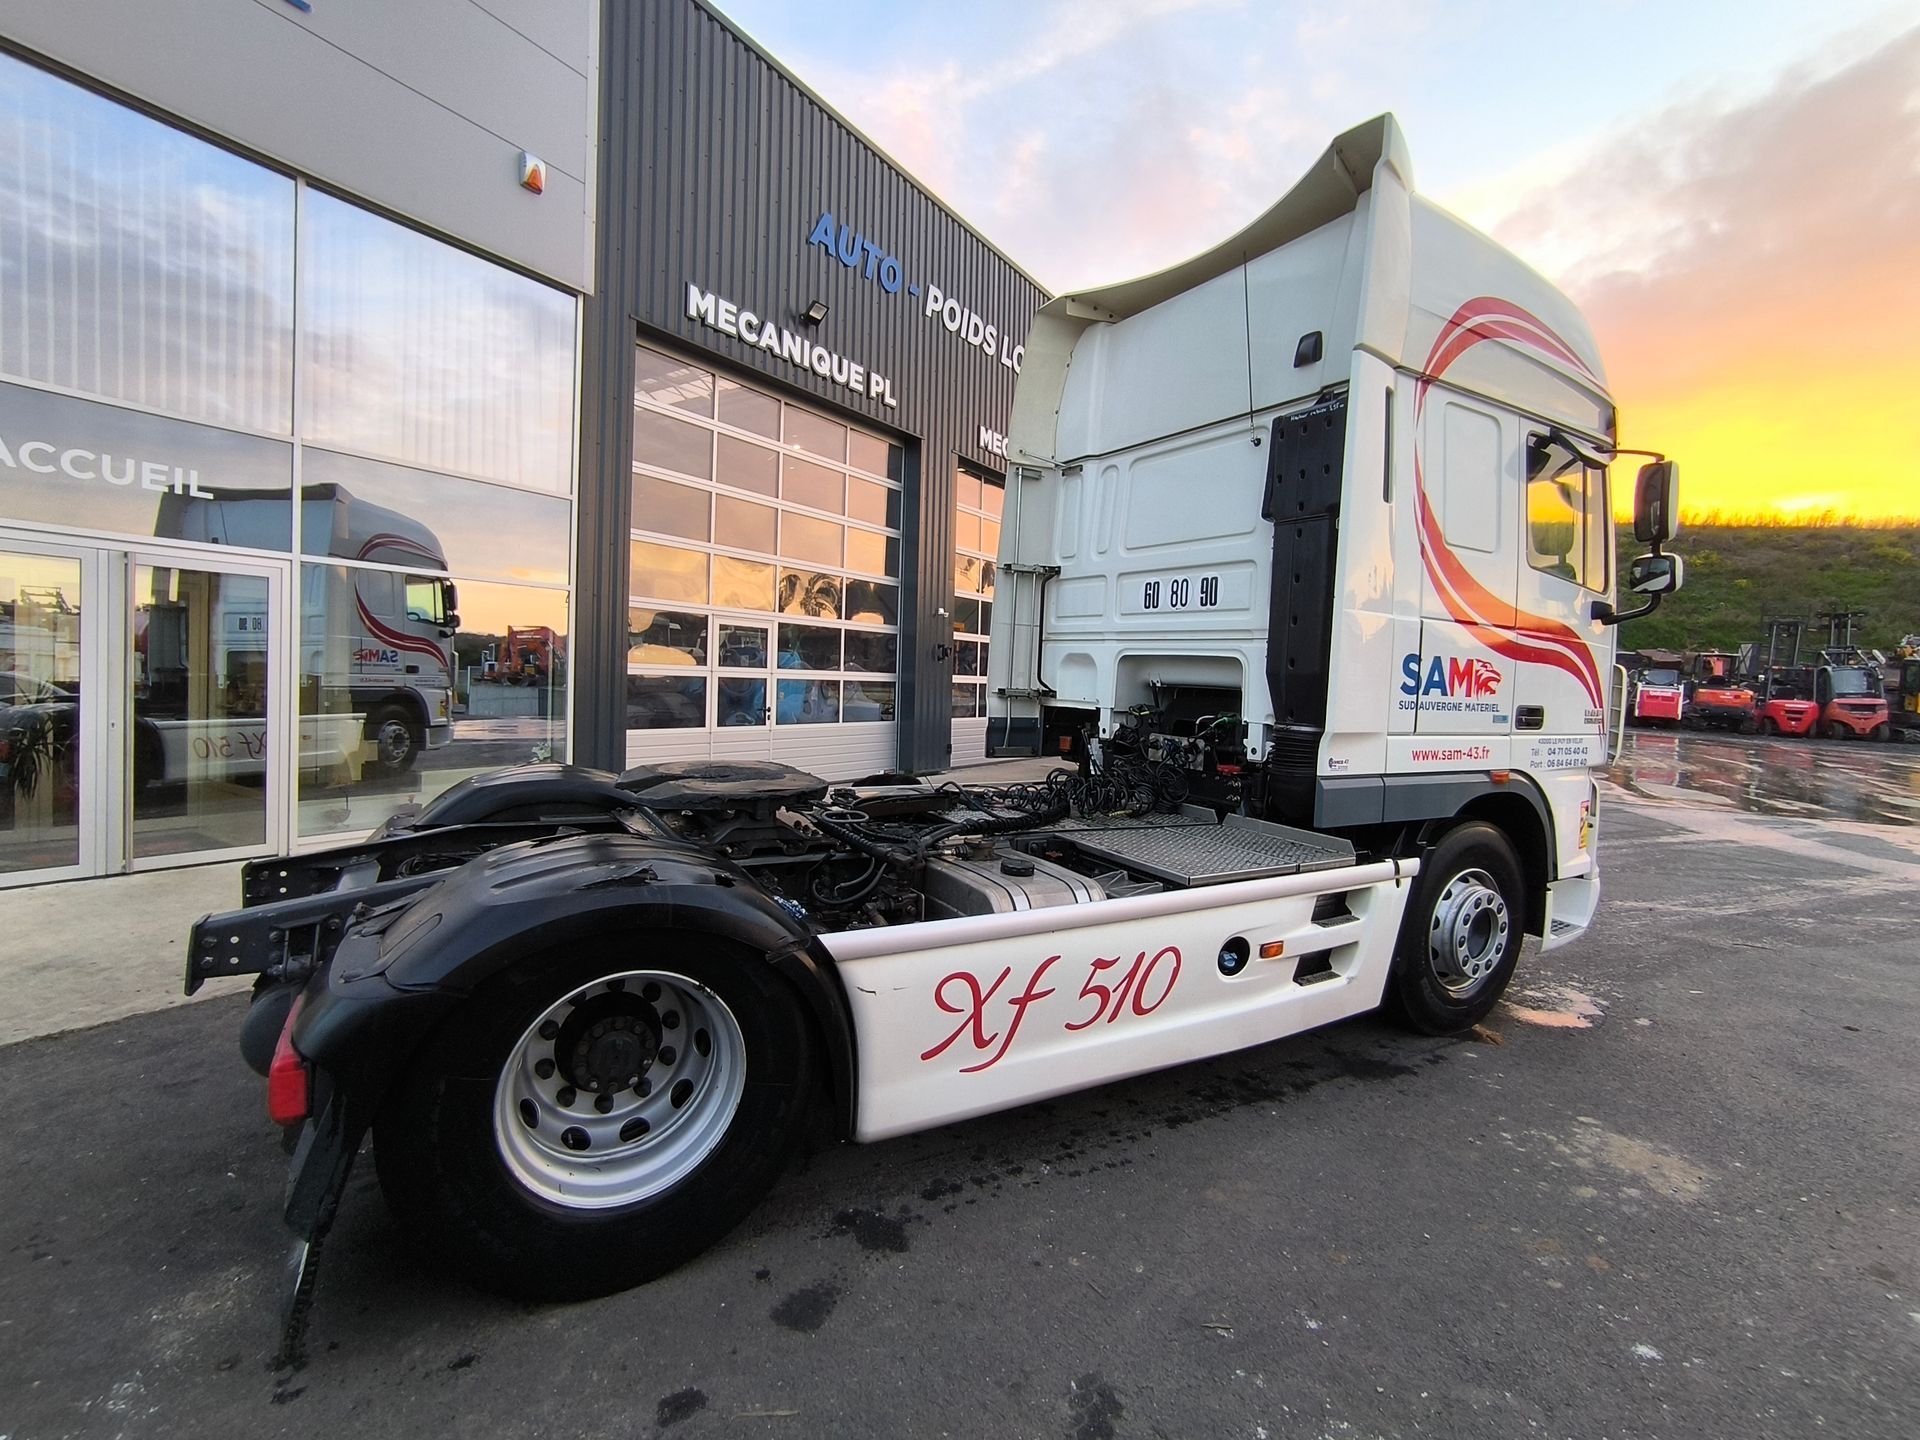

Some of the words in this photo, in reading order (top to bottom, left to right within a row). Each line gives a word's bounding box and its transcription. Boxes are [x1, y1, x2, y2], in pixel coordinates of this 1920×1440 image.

[808, 211, 903, 294] AUTO
[925, 284, 997, 356] POIDS
[687, 282, 864, 393] MECANIQUE
[869, 371, 896, 407] PL
[1144, 581, 1160, 609] 60
[1170, 578, 1189, 608] 80
[1200, 576, 1218, 607] 90
[1400, 653, 1475, 698] SAM
[1398, 700, 1416, 711] SUD
[1418, 701, 1463, 712] AUVERGNE
[1464, 702, 1500, 713] MATERIEL
[1412, 747, 1490, 761] www.sam-43.fr
[1547, 747, 1556, 756] 04
[1564, 747, 1572, 755] 05
[1573, 747, 1581, 755] 40
[1064, 946, 1182, 1031] 510
